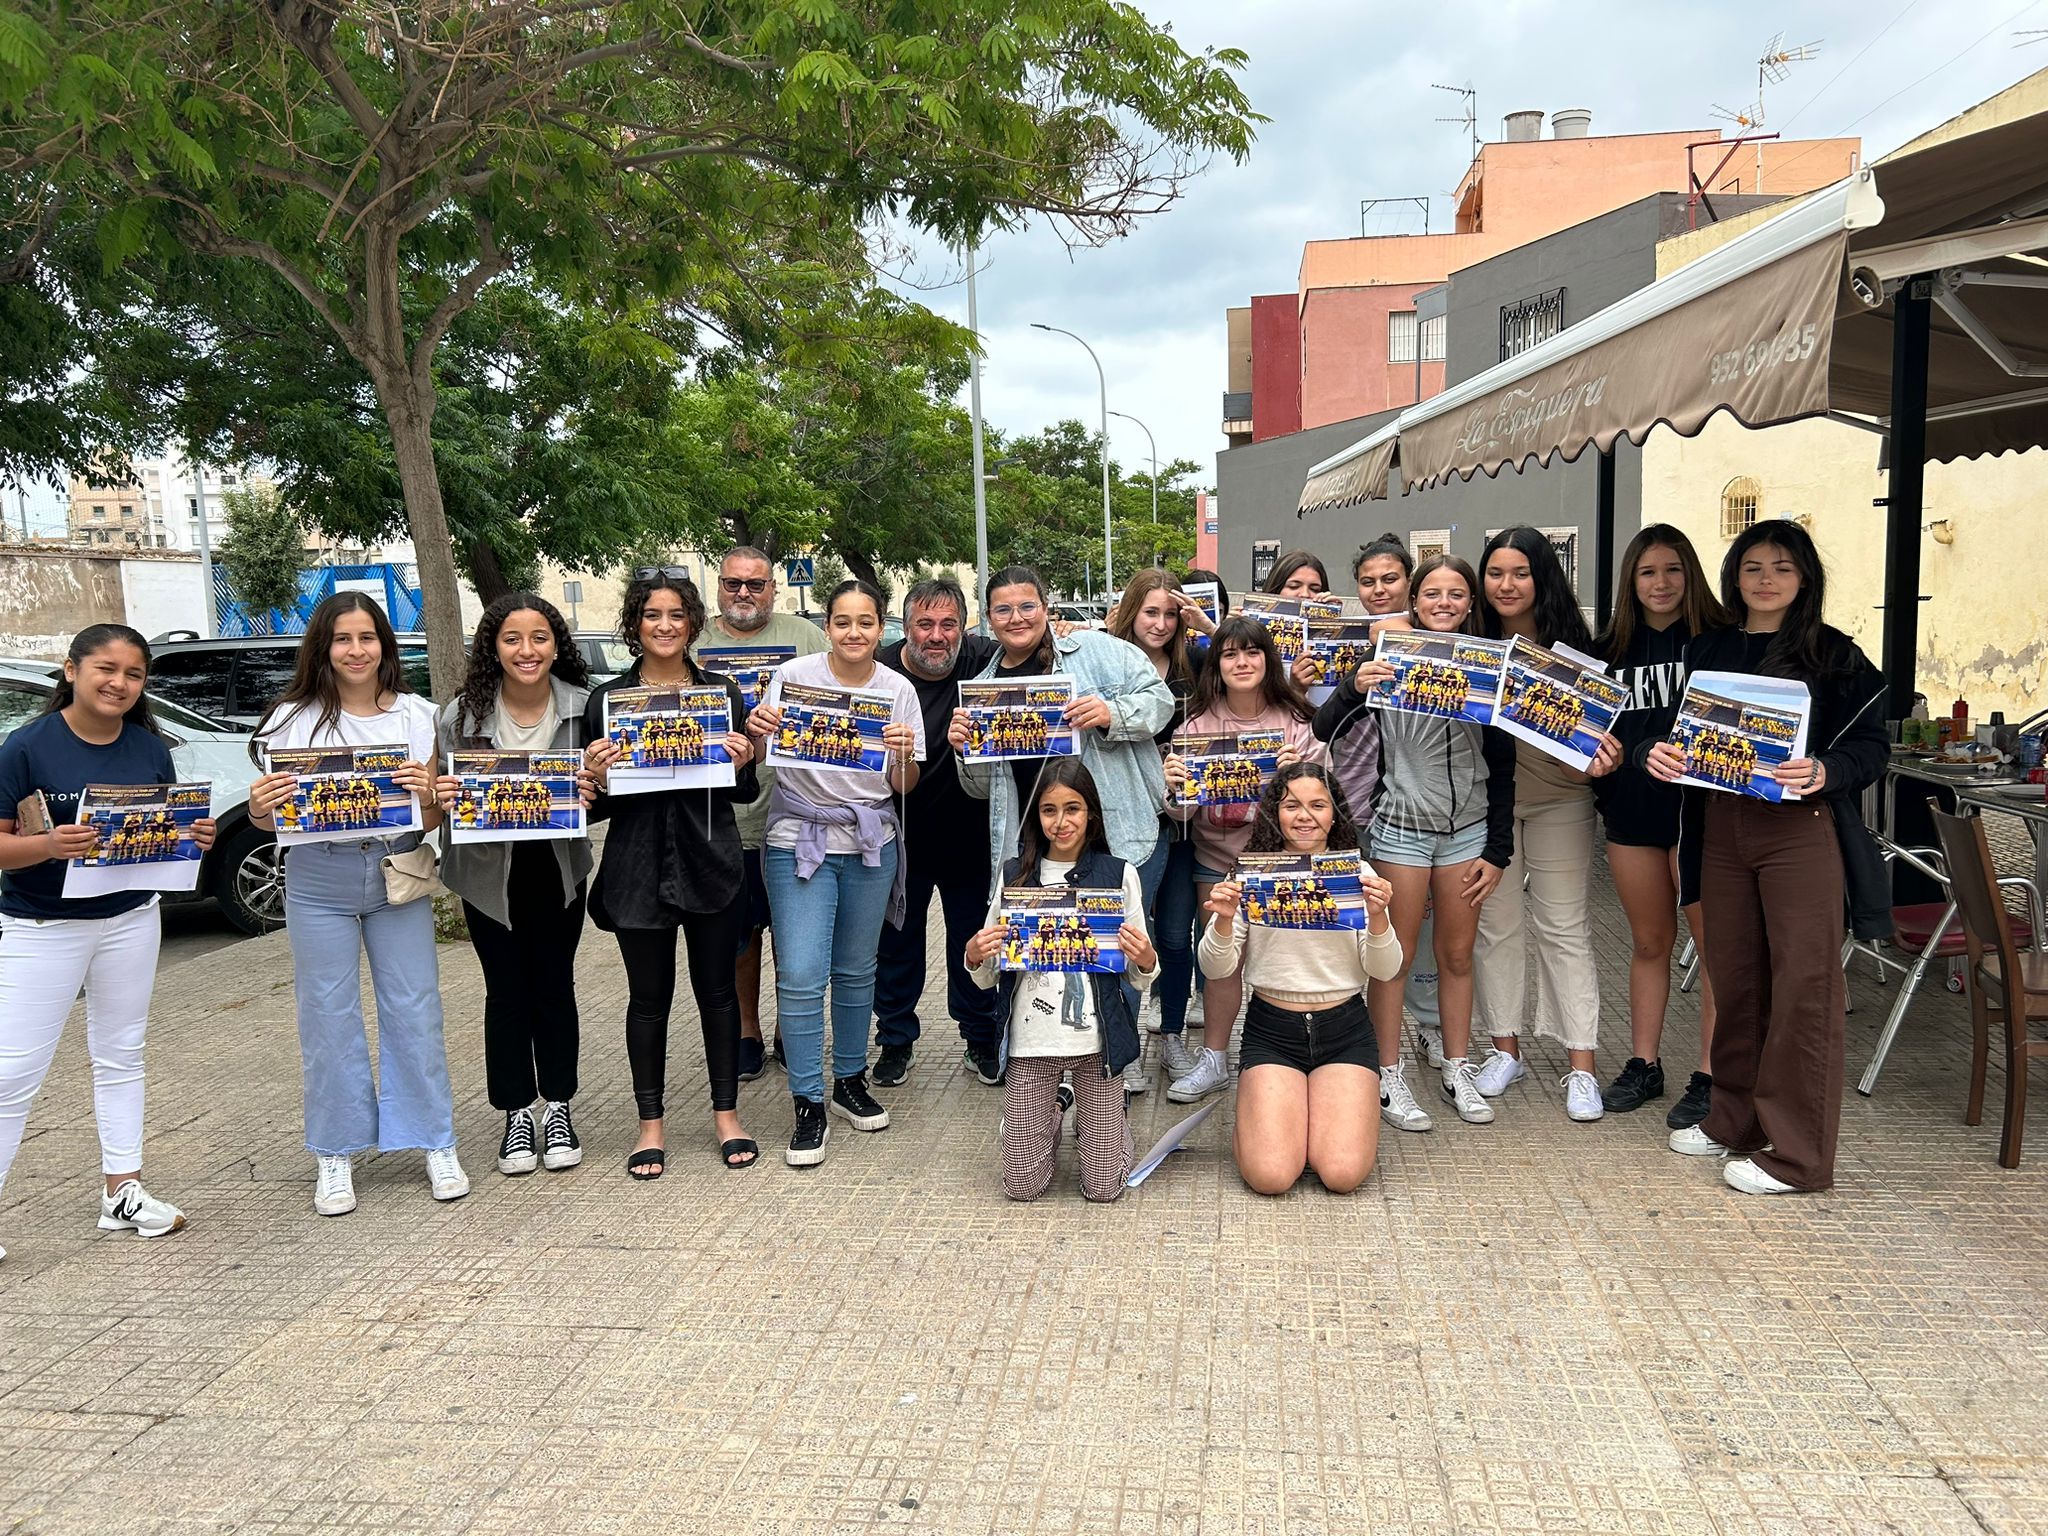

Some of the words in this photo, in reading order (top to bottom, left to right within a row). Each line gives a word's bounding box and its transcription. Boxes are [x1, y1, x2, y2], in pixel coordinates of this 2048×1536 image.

[1711, 348, 1741, 385] 952
[1456, 404, 1495, 454] La
[1489, 374, 1608, 445] Espiguera
